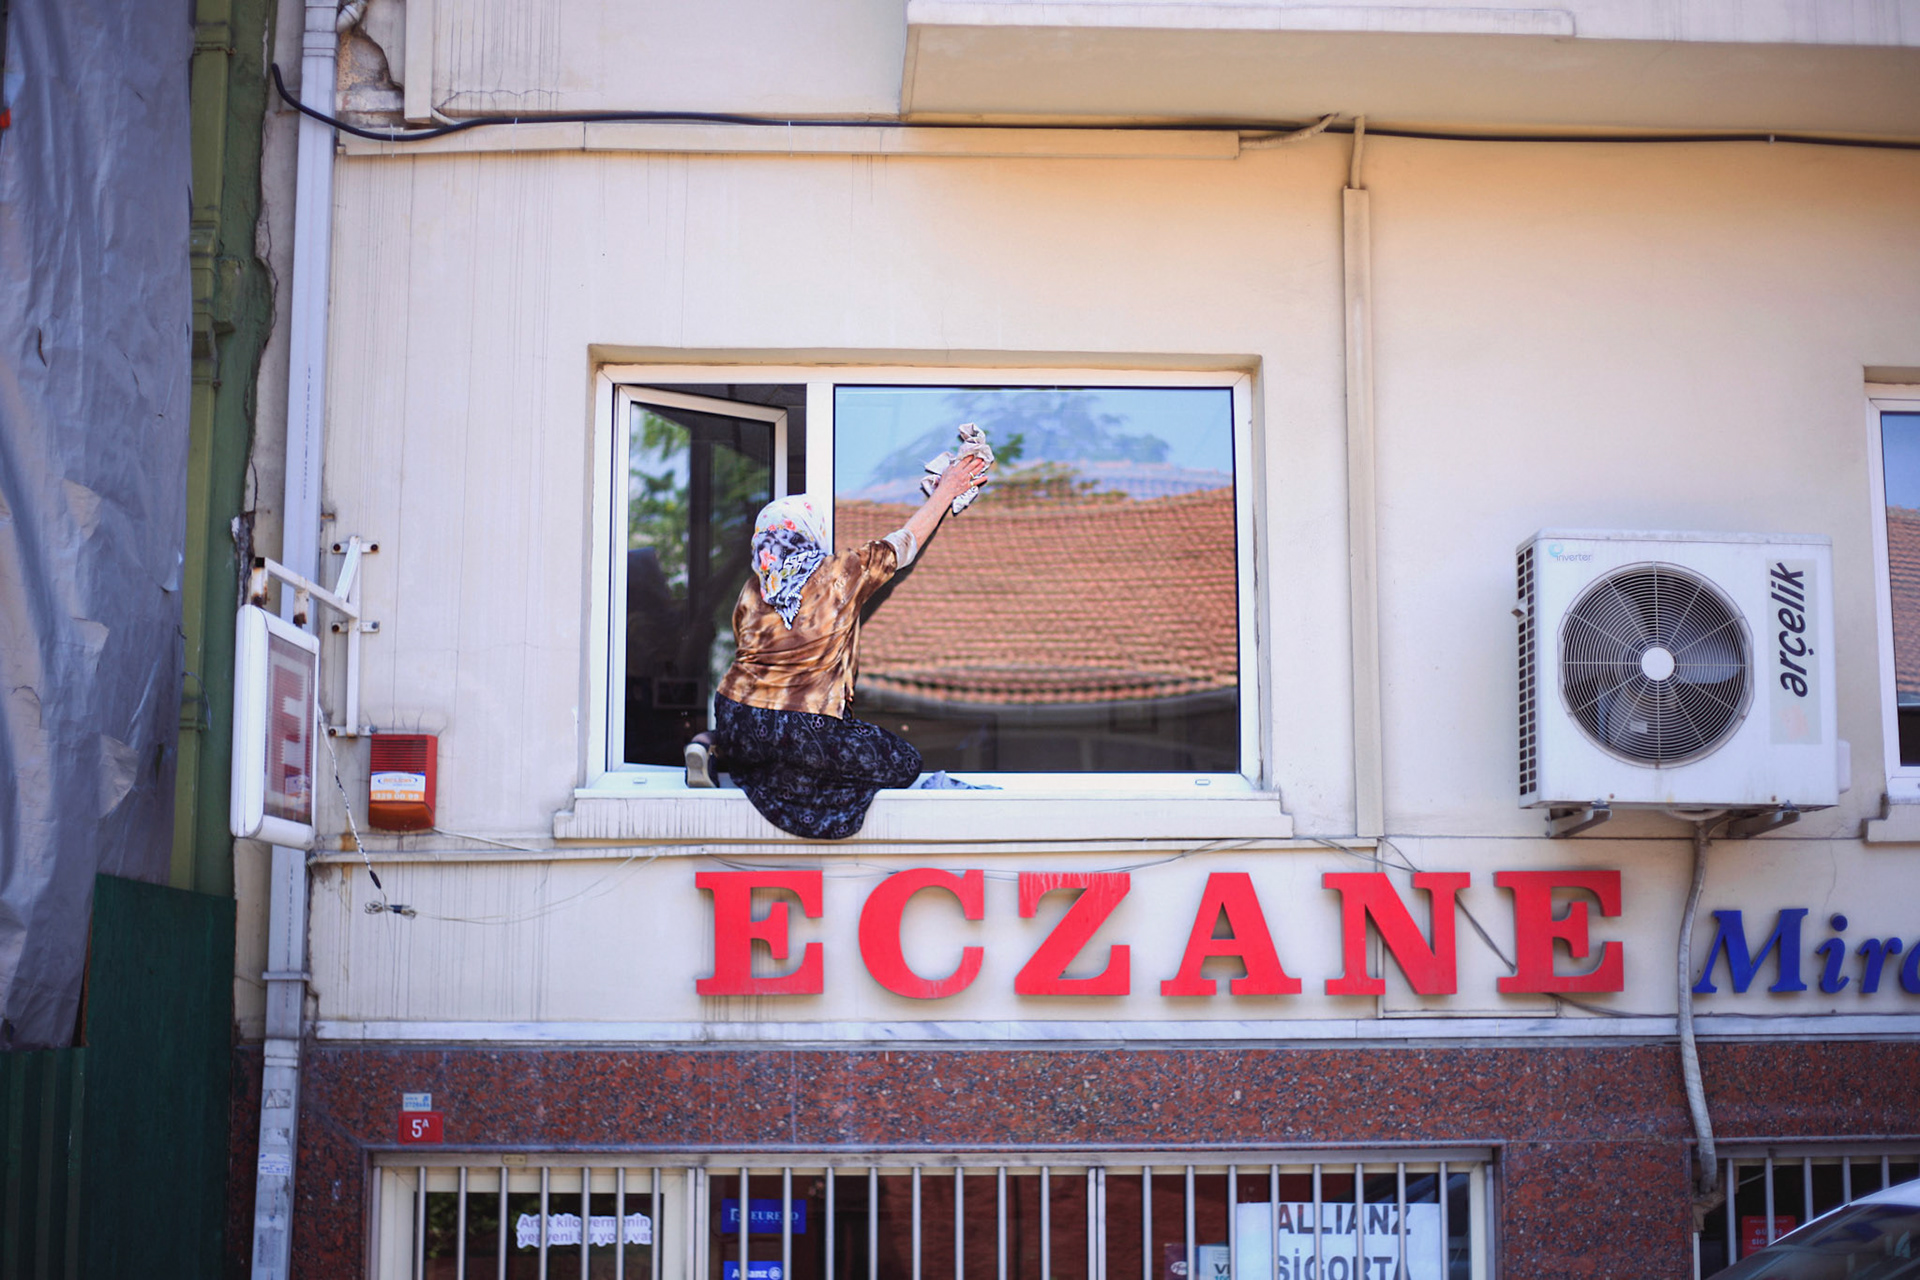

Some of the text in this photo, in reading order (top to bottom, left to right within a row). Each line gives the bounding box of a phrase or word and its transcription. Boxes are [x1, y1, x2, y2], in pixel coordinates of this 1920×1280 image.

[1556, 553, 1592, 562] inverter
[1770, 562, 1814, 698] arçelik
[695, 867, 1624, 999] ECZANE
[751, 1211, 799, 1221] EUREO
